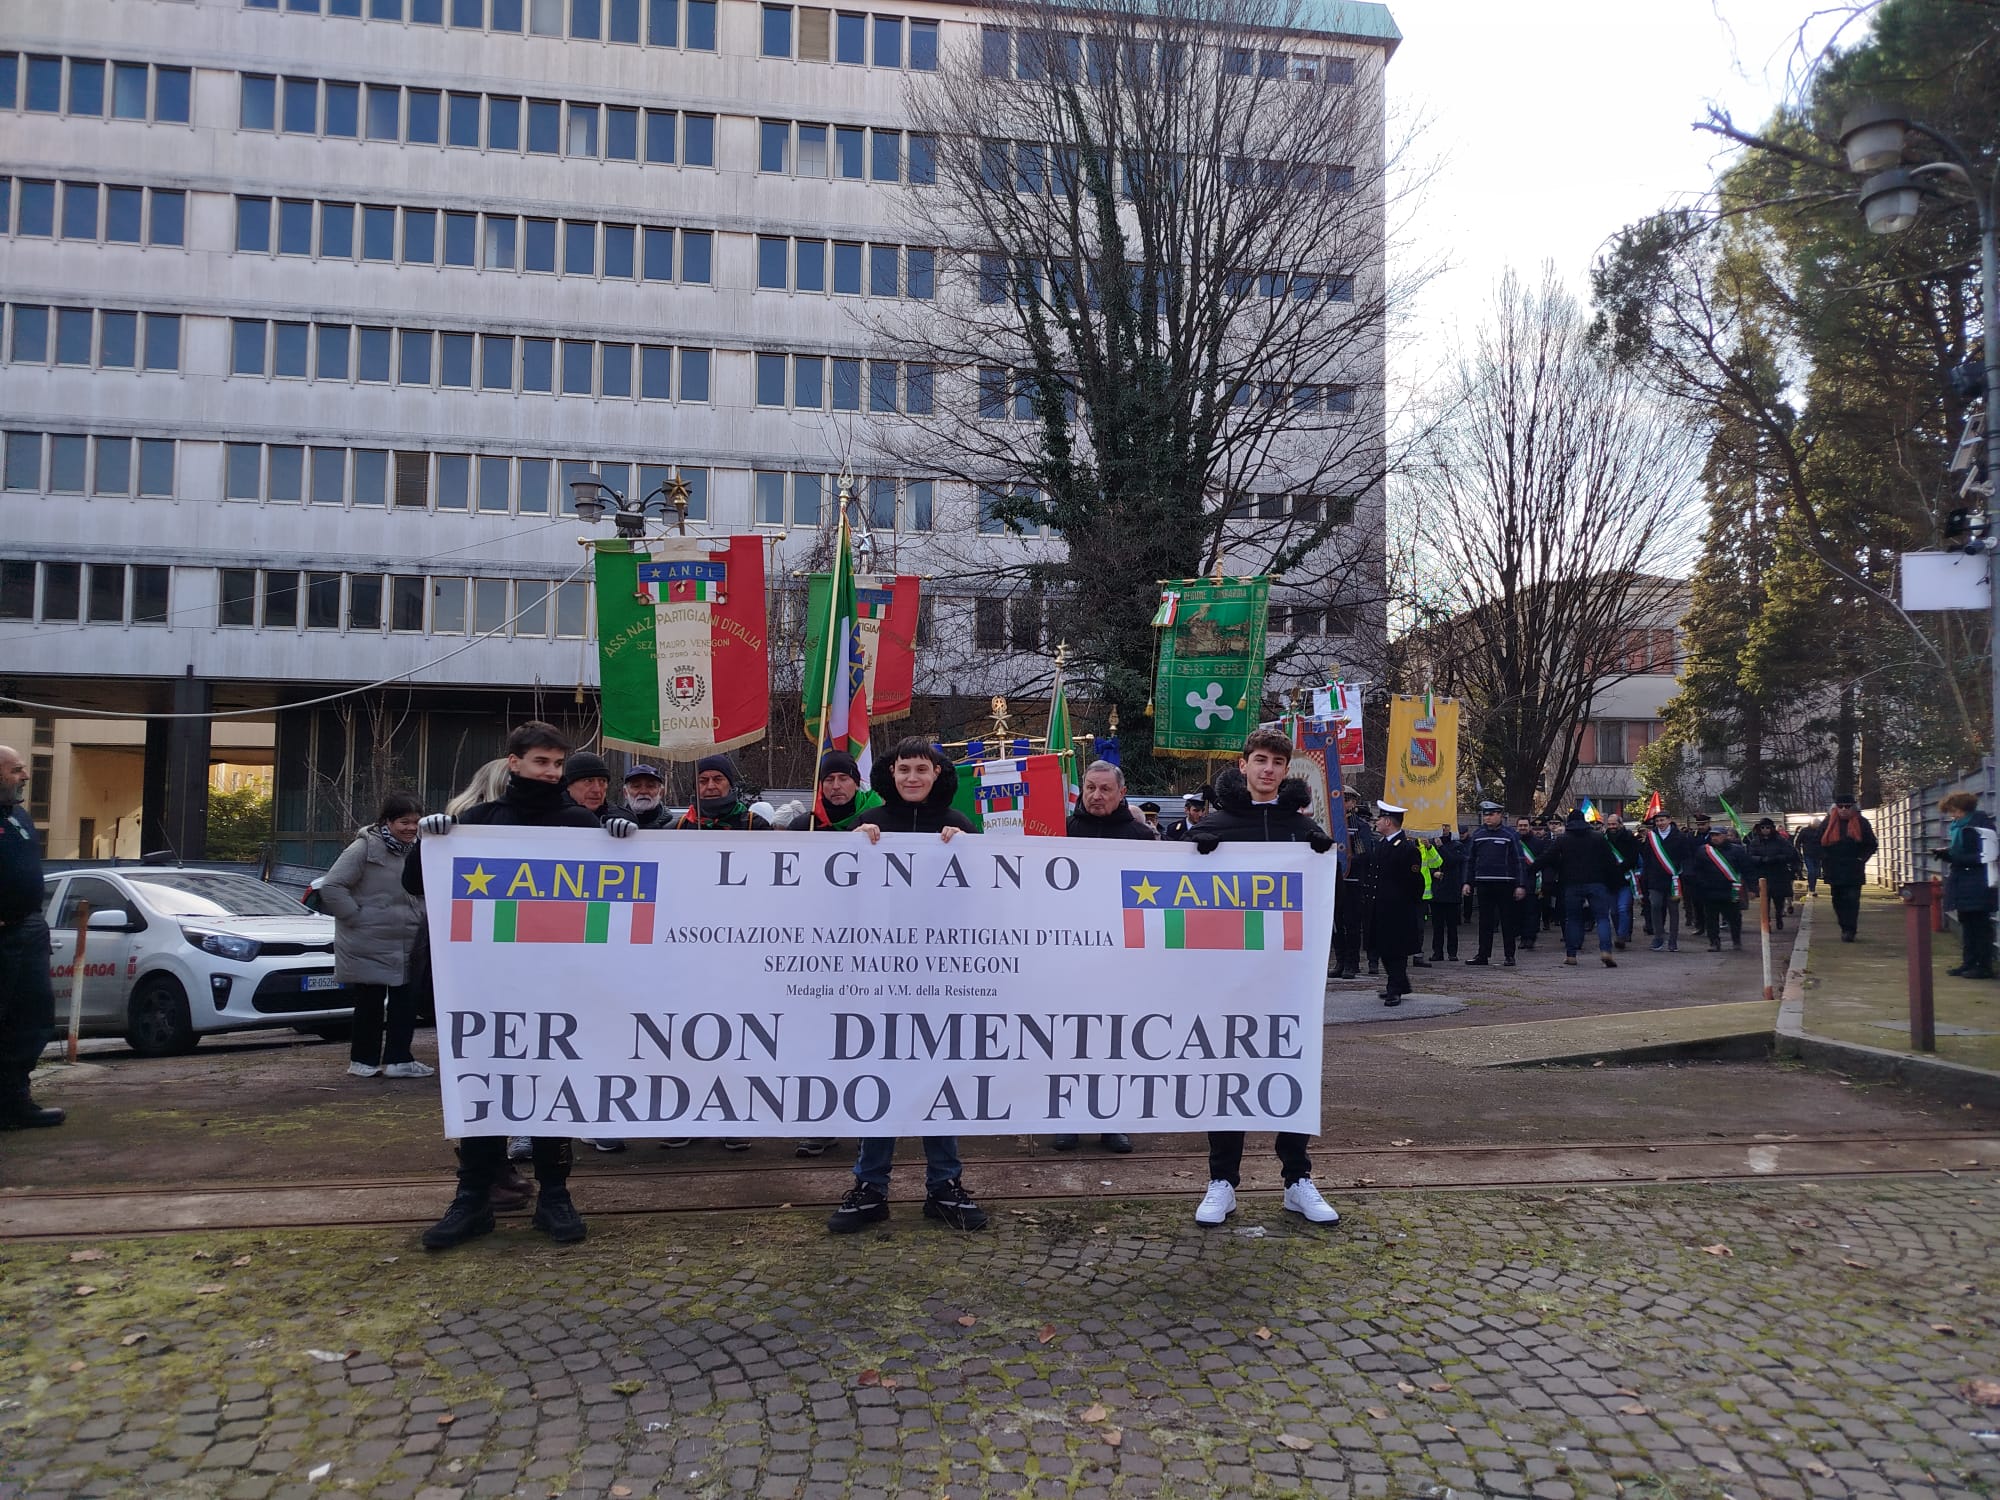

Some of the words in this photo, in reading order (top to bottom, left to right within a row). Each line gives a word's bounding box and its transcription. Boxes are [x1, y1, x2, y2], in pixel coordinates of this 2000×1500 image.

[656, 608, 719, 625] PARTIGIANI
[720, 617, 762, 652] D'ITALIA
[659, 640, 686, 649] MAURO
[691, 638, 730, 648] VENEGONI
[651, 716, 721, 732] LEGNANO
[506, 863, 646, 899] A.N.P.I.
[716, 851, 1079, 890] LEGNANO
[1173, 875, 1293, 908] A.N.P.I.
[665, 927, 805, 944] ASSOCIAZIONE
[811, 927, 918, 945] NAZIONALE
[924, 928, 1030, 946] PARTIGIANI
[1036, 930, 1114, 947] D'ITALIA
[764, 955, 844, 973] SEZIONE
[850, 955, 918, 973] MAURO
[925, 956, 1020, 974] VENEGONI
[786, 984, 834, 998] Medaglia
[838, 984, 870, 996] d'Oro
[874, 984, 883, 996] al
[888, 985, 912, 996] V.M.
[916, 984, 940, 996] della
[945, 985, 997, 997] Resistenza
[446, 1010, 584, 1061] PER
[627, 1012, 785, 1062] NON
[828, 1012, 1304, 1061] DIMENTICARE
[922, 1074, 1012, 1122] AL
[1043, 1072, 1304, 1120] FUTURO
